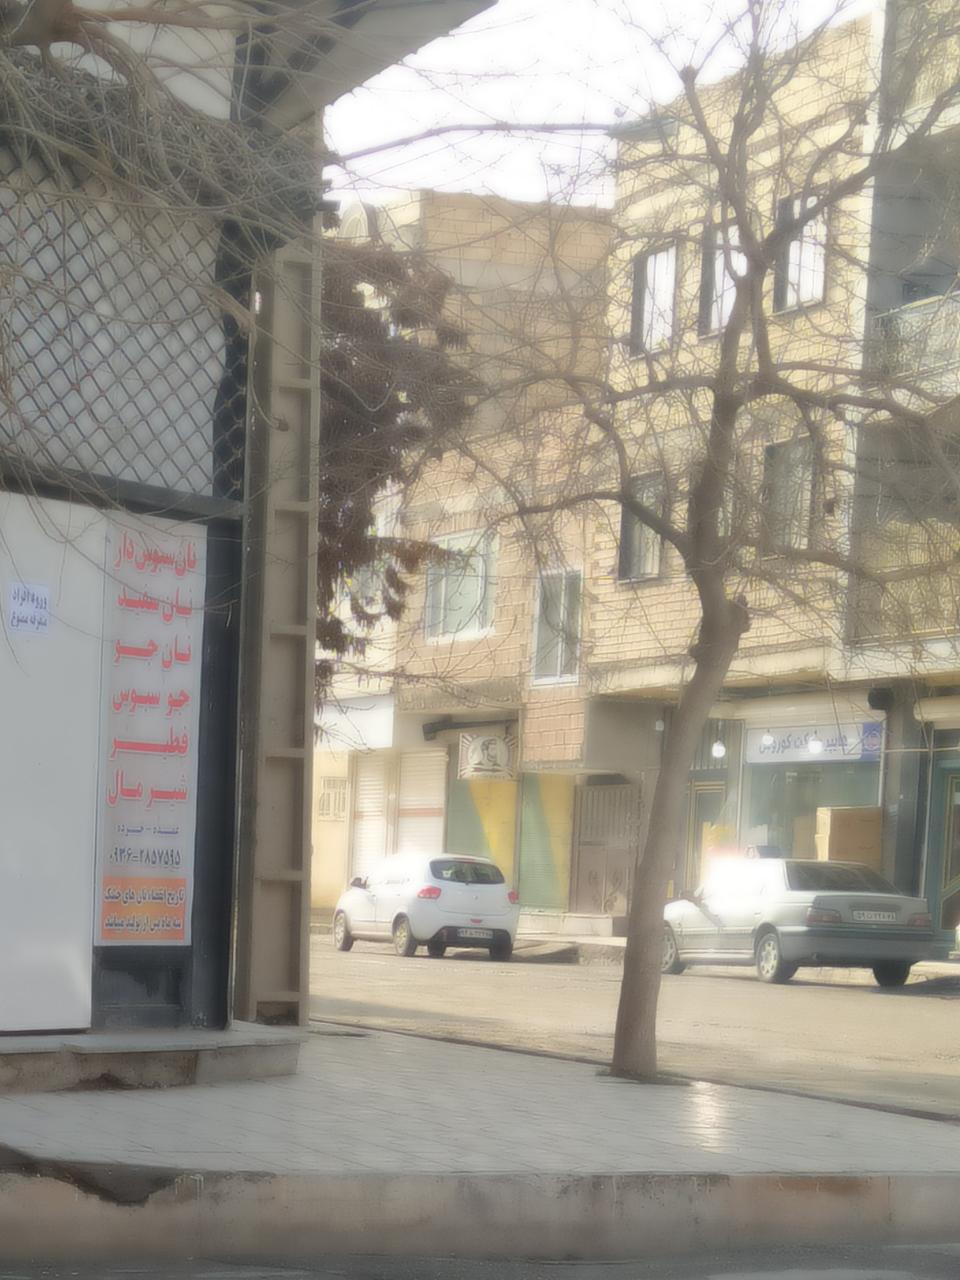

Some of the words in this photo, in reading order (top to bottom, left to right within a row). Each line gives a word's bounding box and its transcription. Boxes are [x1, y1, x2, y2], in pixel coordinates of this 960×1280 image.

[175, 540, 196, 577] نان
[162, 586, 193, 623] نان
[114, 639, 159, 666] جو
[162, 633, 191, 669] نان
[113, 688, 160, 713] سبوس
[166, 689, 191, 717] جو
[111, 725, 189, 760] فطیر
